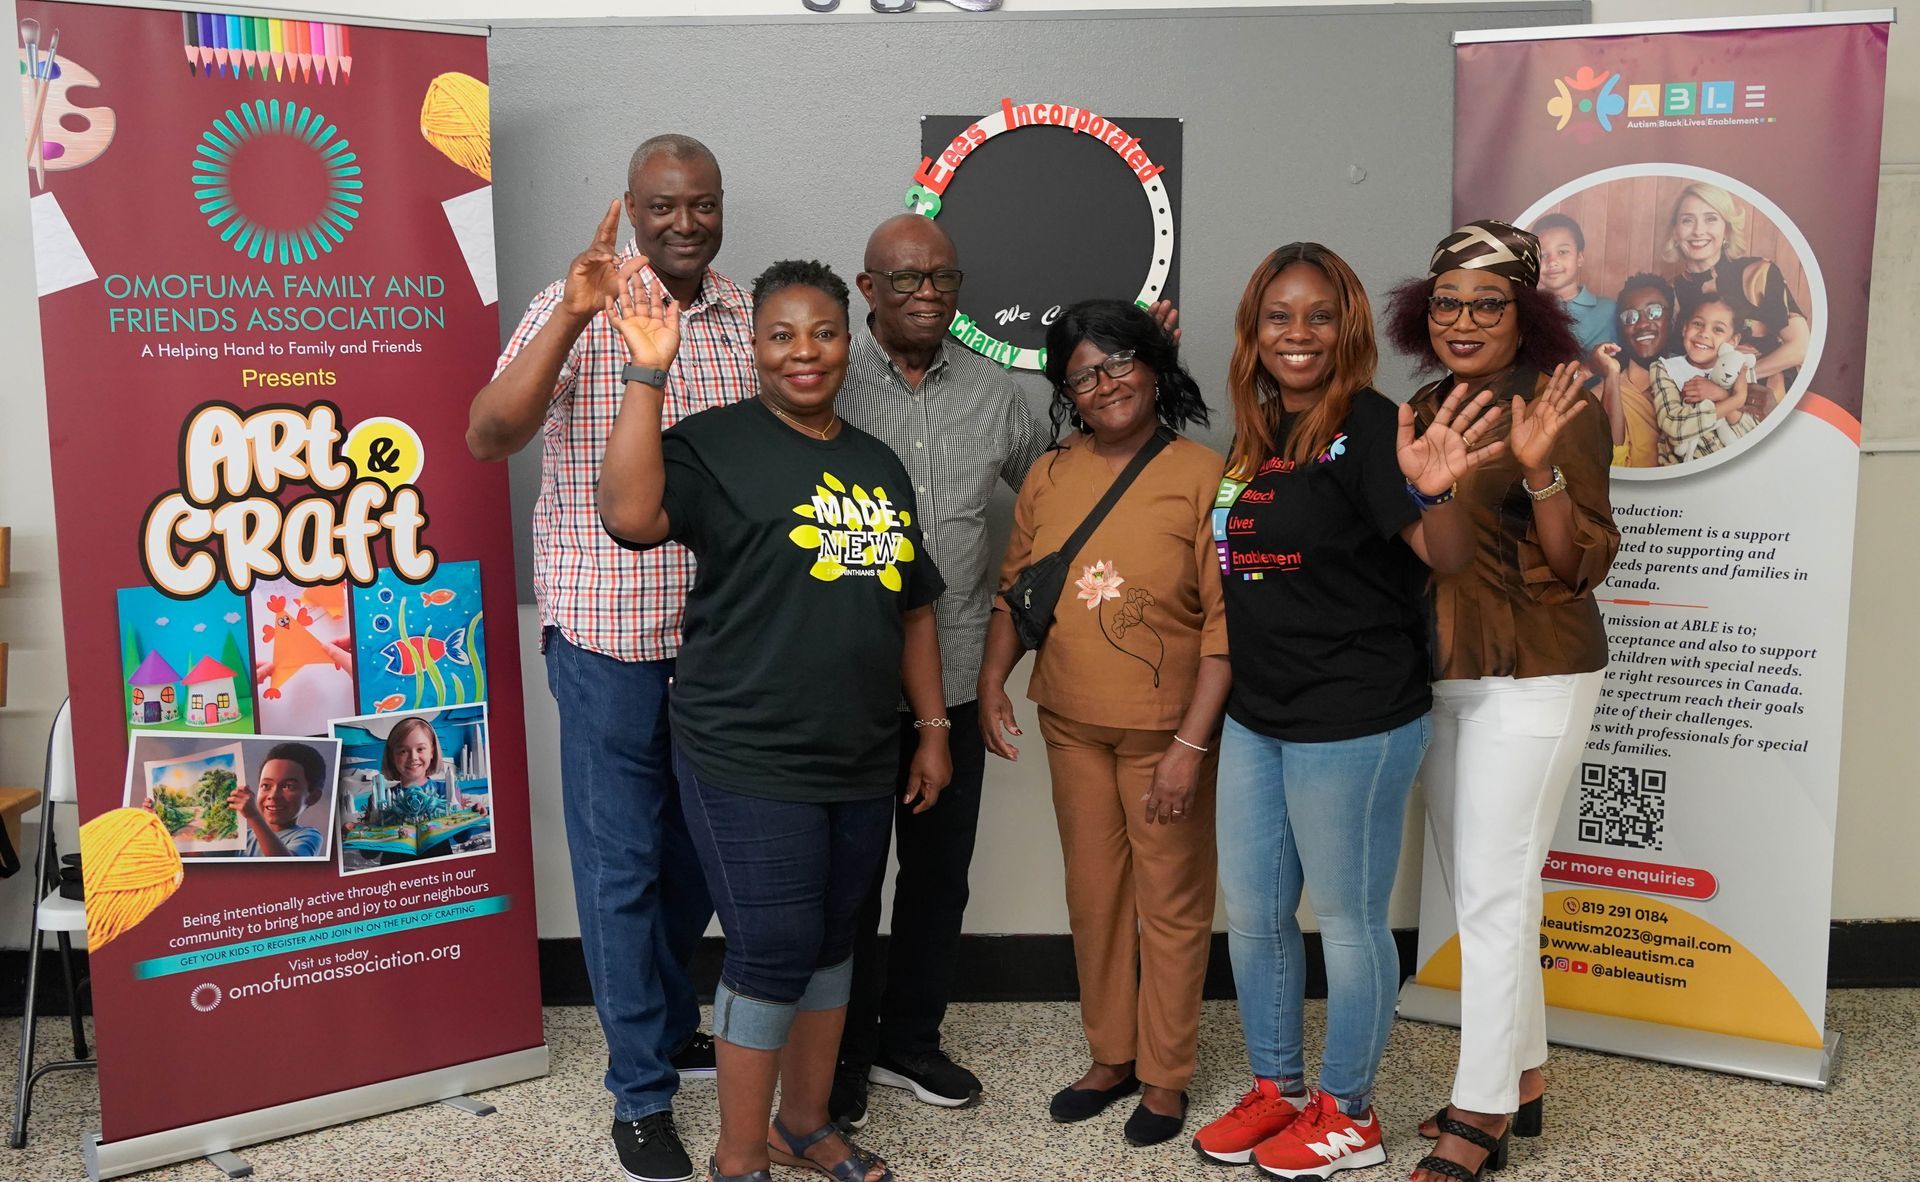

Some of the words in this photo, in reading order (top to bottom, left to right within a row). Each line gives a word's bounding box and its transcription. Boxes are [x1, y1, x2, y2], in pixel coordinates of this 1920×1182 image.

[905, 185, 942, 219] 3
[1001, 97, 1165, 184] Incorporated
[104, 274, 275, 299] OMOFUMA
[283, 275, 376, 298] FAMILY
[384, 275, 445, 298] AND
[109, 307, 238, 333] FRIENDS
[246, 306, 445, 331] ASSOCIATION
[994, 304, 1032, 326] We
[141, 344, 154, 358] A
[159, 343, 219, 360] Helping
[223, 342, 265, 356] Hand
[269, 344, 284, 355] to
[288, 340, 336, 357] Family
[340, 340, 367, 354] and
[372, 339, 422, 354] Friends
[950, 313, 1022, 370] Charity
[242, 368, 337, 388] Presents
[366, 437, 401, 473] &
[1241, 488, 1276, 501] Black
[811, 495, 901, 527] MADE
[1228, 516, 1255, 530] Lives
[1611, 504, 1683, 518] roduction:
[1622, 523, 1703, 538] enablement
[1707, 526, 1719, 538] is
[1722, 530, 1730, 539] a
[1734, 530, 1791, 544] support
[817, 529, 904, 565] NEW
[1232, 550, 1302, 565] Enablement
[1649, 543, 1663, 554] to
[1666, 545, 1744, 561] supporting
[1748, 548, 1776, 560] and
[1611, 559, 1642, 571] eeds
[1644, 562, 1699, 575] parents
[1701, 564, 1729, 576] and
[1729, 564, 1790, 580] families
[1794, 568, 1808, 581] in
[1605, 575, 1660, 591] Canada.
[1607, 615, 1660, 629] mission
[1664, 619, 1679, 630] at
[1680, 619, 1719, 633] ABLE
[1722, 622, 1734, 634] is
[1737, 624, 1757, 637] to;
[1607, 634, 1676, 648] cceptance
[1679, 638, 1706, 650] and
[1708, 640, 1738, 653] also
[1742, 643, 1756, 655] to
[1759, 646, 1818, 660] support
[1611, 651, 1667, 666] children
[1670, 656, 1701, 669] with
[1704, 660, 1755, 673] special
[1757, 664, 1802, 677] needs.
[1619, 669, 1654, 685] right
[1656, 674, 1723, 689] resources
[1726, 678, 1740, 690] in
[1744, 679, 1802, 696] Canada.
[1617, 690, 1681, 704] spectrum
[1685, 695, 1723, 707] reach
[1727, 697, 1762, 710] their
[1764, 702, 1805, 715] goals
[1594, 704, 1619, 717] pite
[1622, 705, 1639, 721] of
[1639, 707, 1672, 721] their
[1675, 711, 1752, 730] challenges.
[1604, 723, 1634, 736] with
[1636, 726, 1729, 745] professionals
[1730, 734, 1754, 749] for
[1757, 740, 1808, 753] special
[1611, 740, 1671, 758] families.
[1571, 862, 1613, 877] more
[1617, 867, 1695, 888] enquiries
[183, 913, 221, 928] Being
[223, 896, 304, 921] intentionally
[306, 890, 344, 906] active
[347, 880, 397, 899] through
[400, 874, 440, 890] events
[442, 871, 453, 882] in
[455, 868, 476, 880] our
[169, 925, 244, 948] community
[248, 923, 261, 934] to
[265, 915, 299, 931] bring
[301, 908, 333, 924] hope
[336, 903, 360, 917] and
[362, 900, 381, 916] joy
[383, 898, 397, 909] to
[400, 894, 421, 906] our
[423, 881, 489, 902] neighbours
[1581, 901, 1605, 915] 819
[1608, 905, 1631, 918] 291
[1635, 909, 1669, 924] 0184
[180, 956, 198, 967] GET
[201, 952, 227, 964] YOUR
[229, 946, 250, 958] KIDS
[252, 943, 265, 954] TO
[267, 936, 307, 951] REGISTER
[309, 931, 329, 943] AND
[331, 927, 351, 939] JOIN
[354, 924, 364, 934] IN
[366, 922, 381, 933] ON
[383, 918, 400, 929] THE
[401, 915, 419, 926] FUN
[421, 912, 433, 922] OF
[435, 904, 476, 919] CRAFTING
[288, 956, 315, 971] Visit
[318, 956, 332, 967] us
[335, 948, 369, 963] today
[1551, 938, 1695, 968] www.ableautism.ca
[229, 943, 461, 1000] omofumaassociation.org
[1591, 964, 1687, 988] @ableautism
